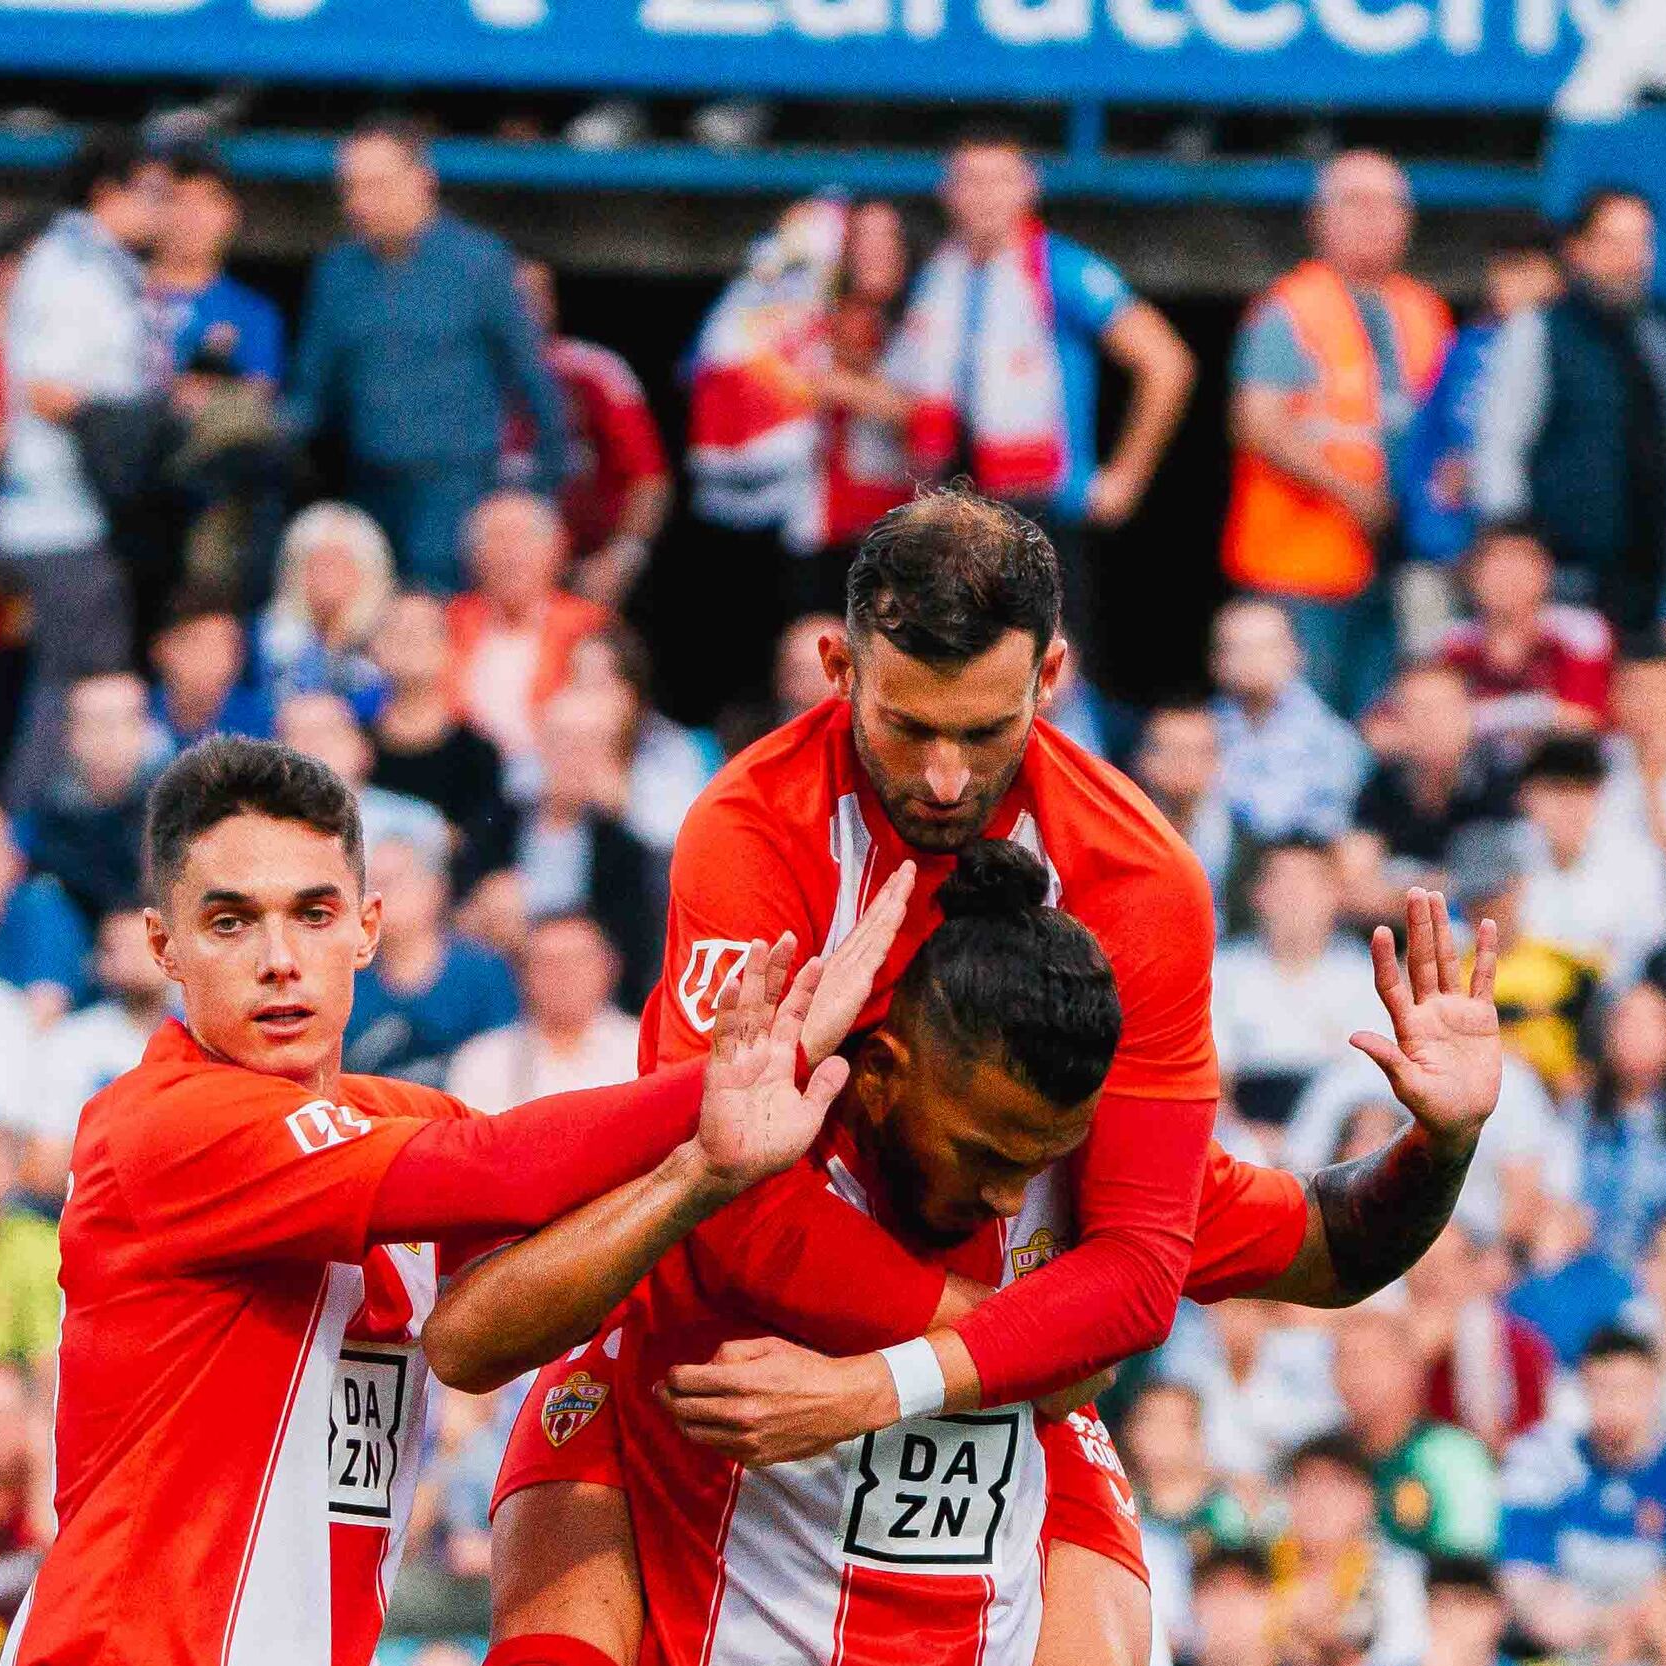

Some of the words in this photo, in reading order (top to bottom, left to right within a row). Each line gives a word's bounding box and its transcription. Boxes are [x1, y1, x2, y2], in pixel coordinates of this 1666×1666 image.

[344, 1377, 381, 1429] DA
[339, 1438, 381, 1490] ZN
[898, 1432, 978, 1485] DA
[888, 1491, 971, 1538] ZN
